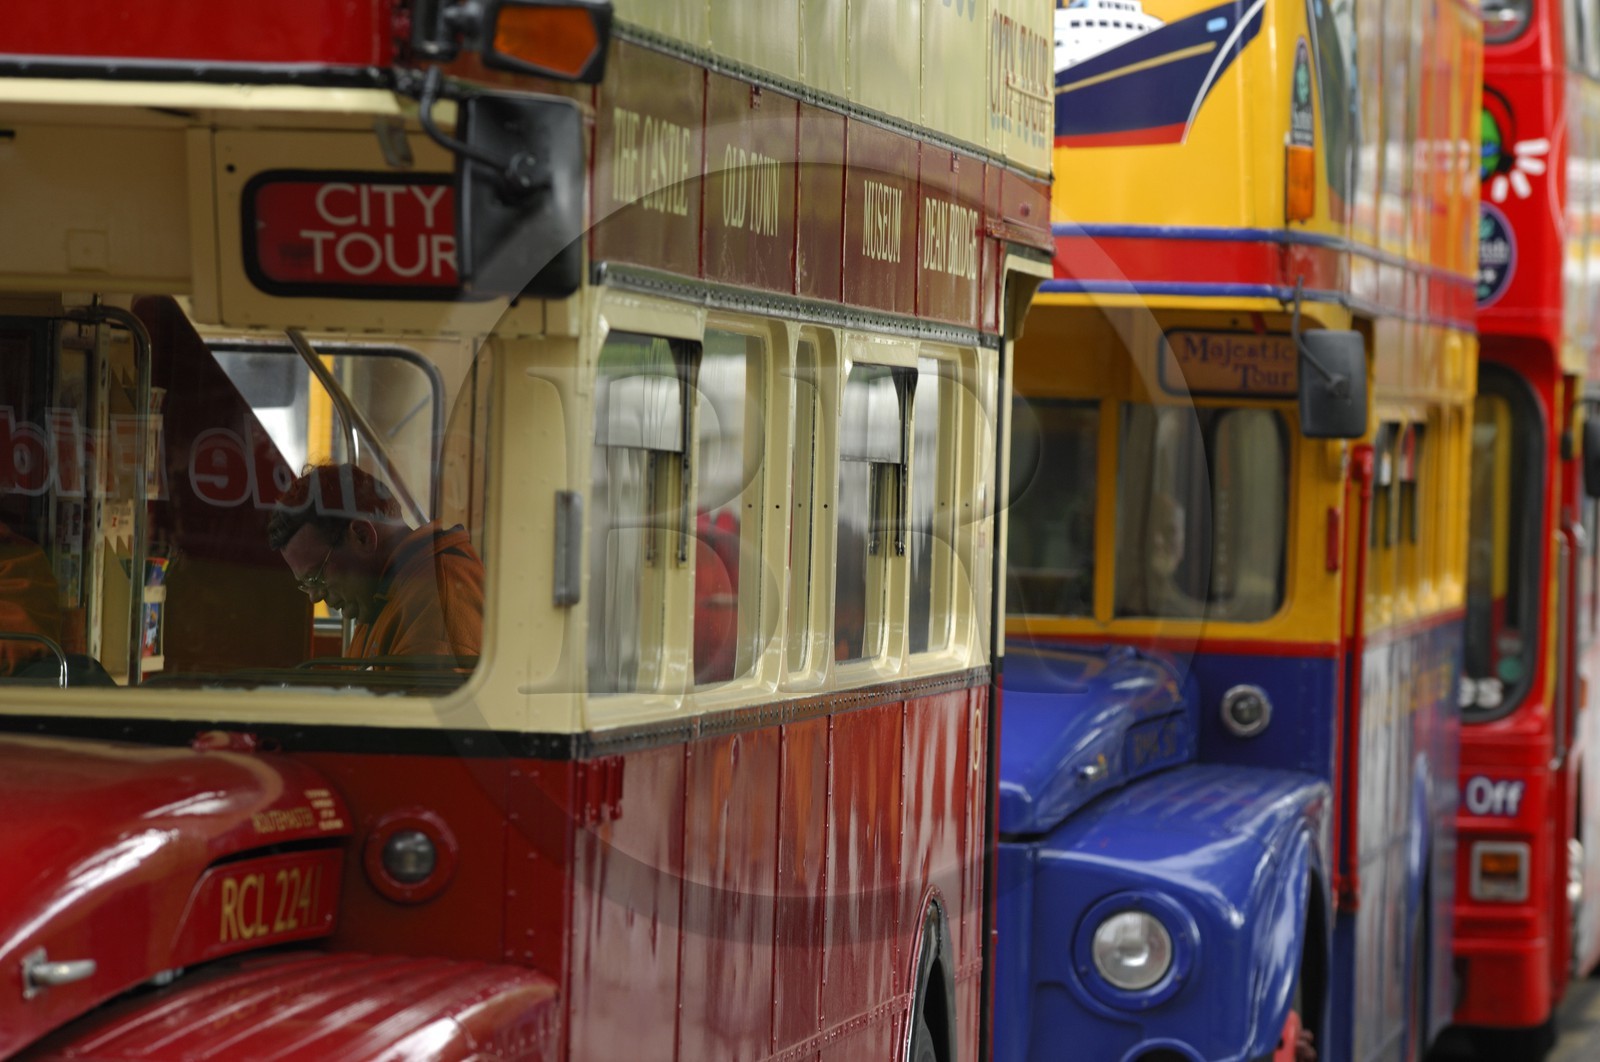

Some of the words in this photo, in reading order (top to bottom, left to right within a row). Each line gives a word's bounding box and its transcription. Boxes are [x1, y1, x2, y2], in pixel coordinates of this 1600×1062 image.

[613, 107, 638, 205] THE
[642, 114, 690, 217] CASTLE
[722, 143, 747, 229] OLD
[749, 150, 781, 238] TOWN
[315, 182, 445, 227] CITY
[862, 179, 903, 264] MUSEUM
[923, 196, 947, 275] DEAN
[948, 203, 979, 281] BRIDGE
[300, 230, 457, 277] TOUR
[1234, 362, 1293, 390] Tour
[1465, 774, 1526, 817] Off
[219, 872, 269, 943] RCL
[273, 862, 323, 933] 2241
